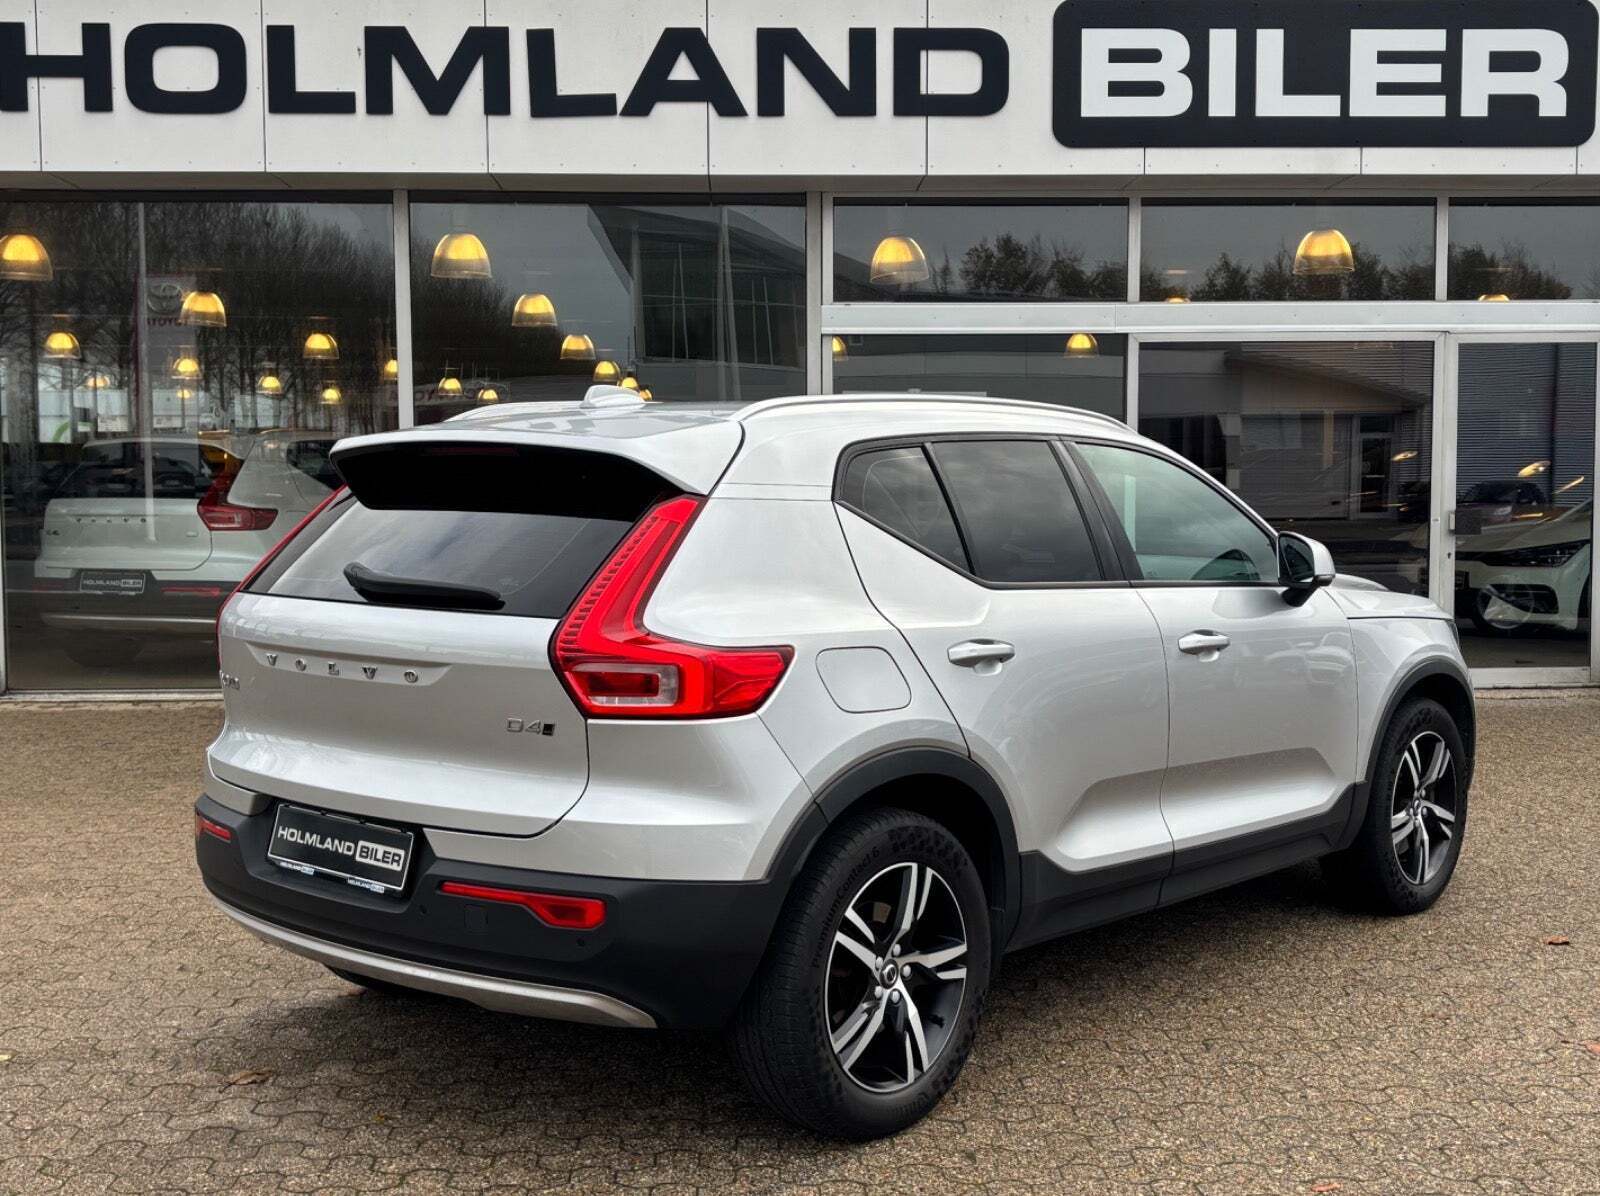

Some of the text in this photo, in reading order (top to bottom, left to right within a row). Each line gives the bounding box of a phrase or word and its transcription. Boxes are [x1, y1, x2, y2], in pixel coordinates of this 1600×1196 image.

[0, 22, 1569, 117] HOLMLAND BILER
[265, 652, 419, 683] VOLVO
[277, 825, 402, 868] HOLMLAND BILER
